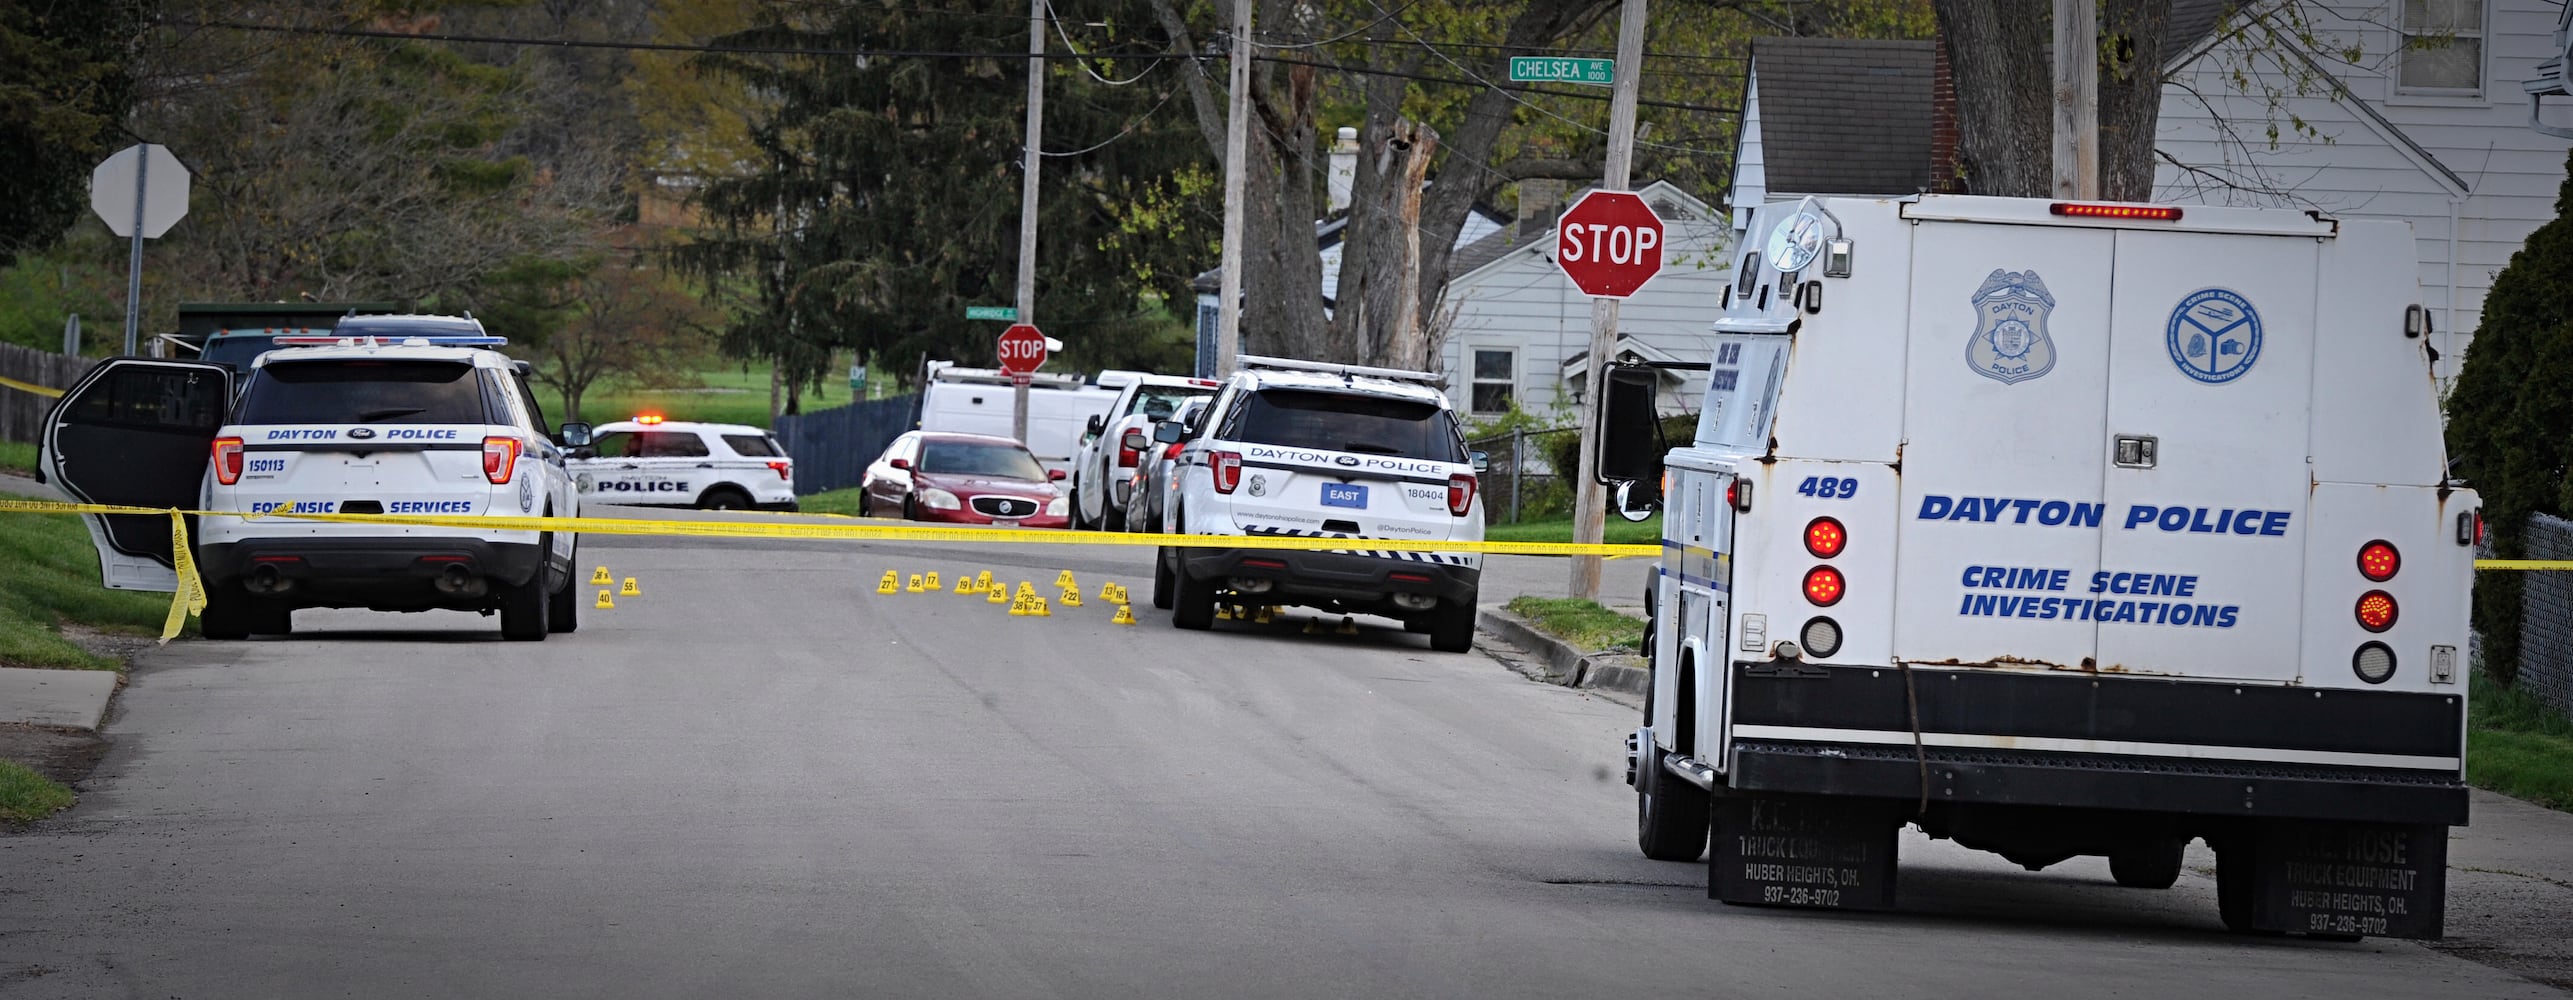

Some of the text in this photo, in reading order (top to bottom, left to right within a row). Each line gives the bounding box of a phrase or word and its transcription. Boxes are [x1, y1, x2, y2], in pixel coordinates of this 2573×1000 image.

[1517, 60, 1604, 78] CHELSEA AVE
[1588, 71, 1606, 81] 1000
[1562, 222, 1658, 265] STOP
[1992, 302, 2034, 315] DAYTON
[2185, 291, 2247, 308] CRIME SCENE
[1000, 340, 1043, 358] STOP
[1992, 363, 2030, 375] POLICE
[267, 429, 338, 440] DAYTON
[386, 429, 457, 439] POLICE
[249, 459, 285, 472] 150113
[1251, 447, 1328, 464] DAYTON
[1366, 458, 1442, 474] POLICE
[597, 481, 689, 492] POLICE
[1330, 489, 1360, 501] EAST
[1407, 488, 1444, 500] 180404
[1798, 477, 1858, 499] 489
[390, 501, 472, 513] SERVICES
[1918, 495, 2291, 536] DAYTON POLICE
[1377, 524, 1432, 536] @DaytonPolice
[1962, 566, 2198, 597] CRIME SCENE
[1960, 594, 2239, 628] INVESTIGATIONS
[1739, 835, 1786, 858] TRUCK
[1745, 863, 1860, 888] HUBER HEIGHTS, OH.
[2285, 861, 2417, 891] TRUCK EQUIPMENT
[1764, 886, 1840, 907] 937-236-9702
[2291, 890, 2408, 916] HUBER HEIGHTS, OH.
[2310, 913, 2388, 935] 937-236-9702
